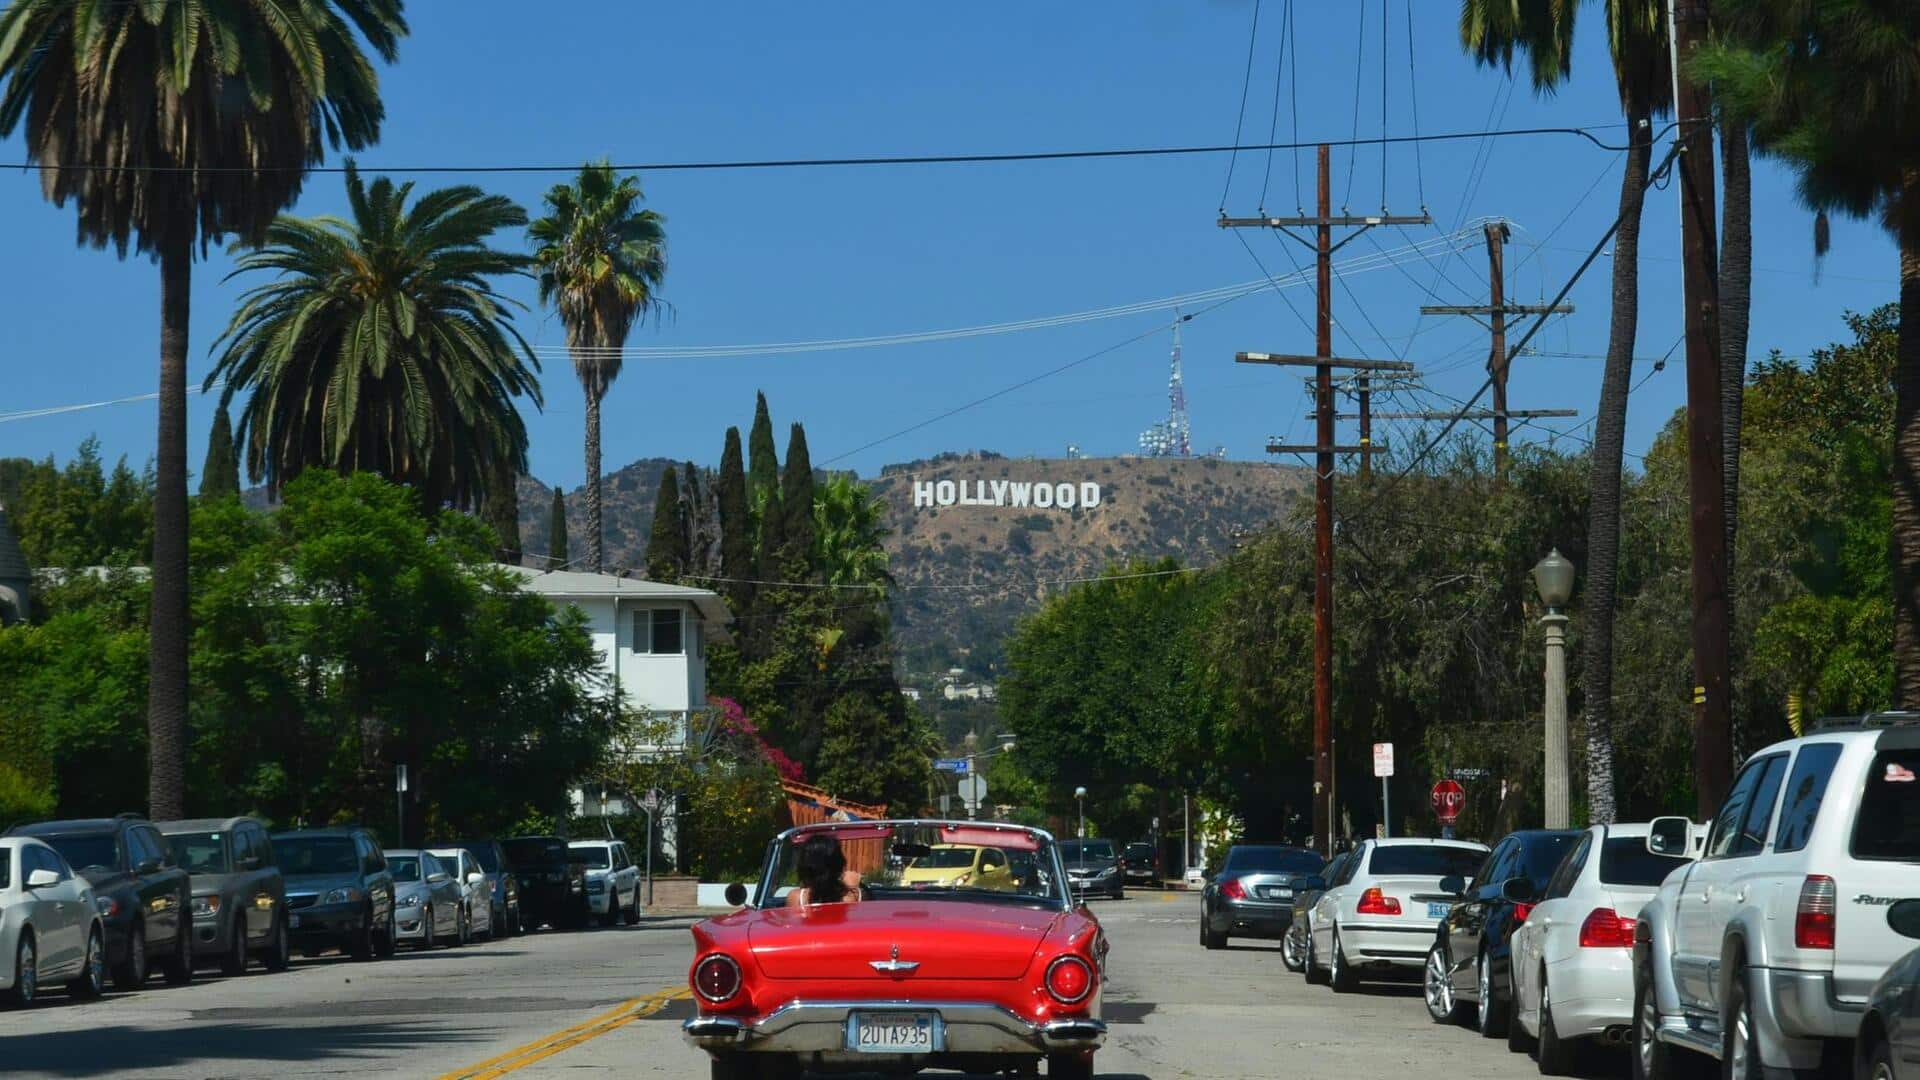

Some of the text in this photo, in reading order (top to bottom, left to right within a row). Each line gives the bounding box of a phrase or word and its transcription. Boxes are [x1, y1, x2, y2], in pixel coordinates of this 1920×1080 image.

[913, 479, 1101, 509] HOLLYWOOD
[1432, 791, 1463, 807] STOP
[861, 1024, 928, 1045] 2UTA935
